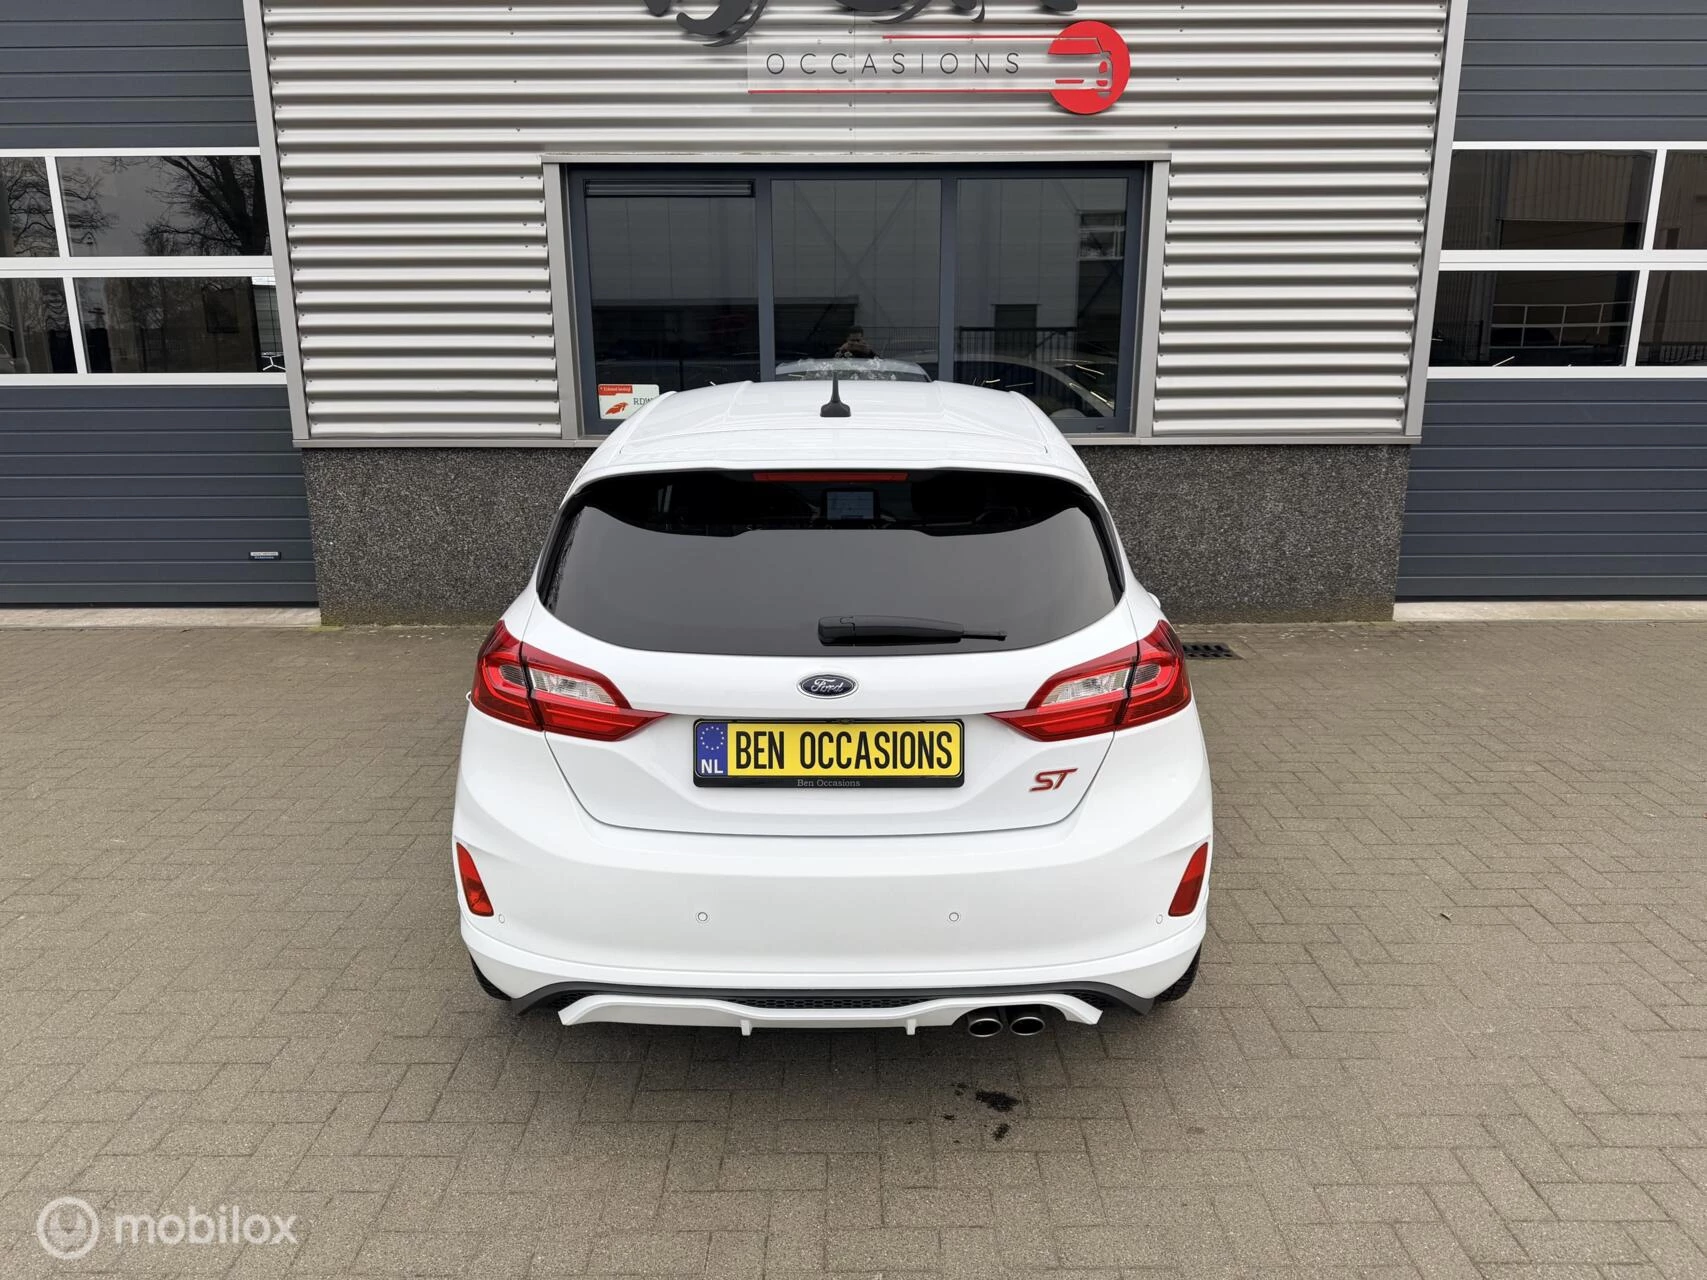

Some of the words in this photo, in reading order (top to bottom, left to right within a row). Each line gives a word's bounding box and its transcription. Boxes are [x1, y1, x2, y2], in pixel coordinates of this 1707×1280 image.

[766, 52, 1021, 75] OCCASIONS
[810, 678, 844, 693] Ford
[735, 731, 785, 769] BEN
[799, 731, 953, 770] OCCASIONS
[701, 759, 723, 774] NL
[797, 779, 814, 787] Ben
[816, 779, 861, 787] Occasions
[1028, 767, 1078, 793] ST
